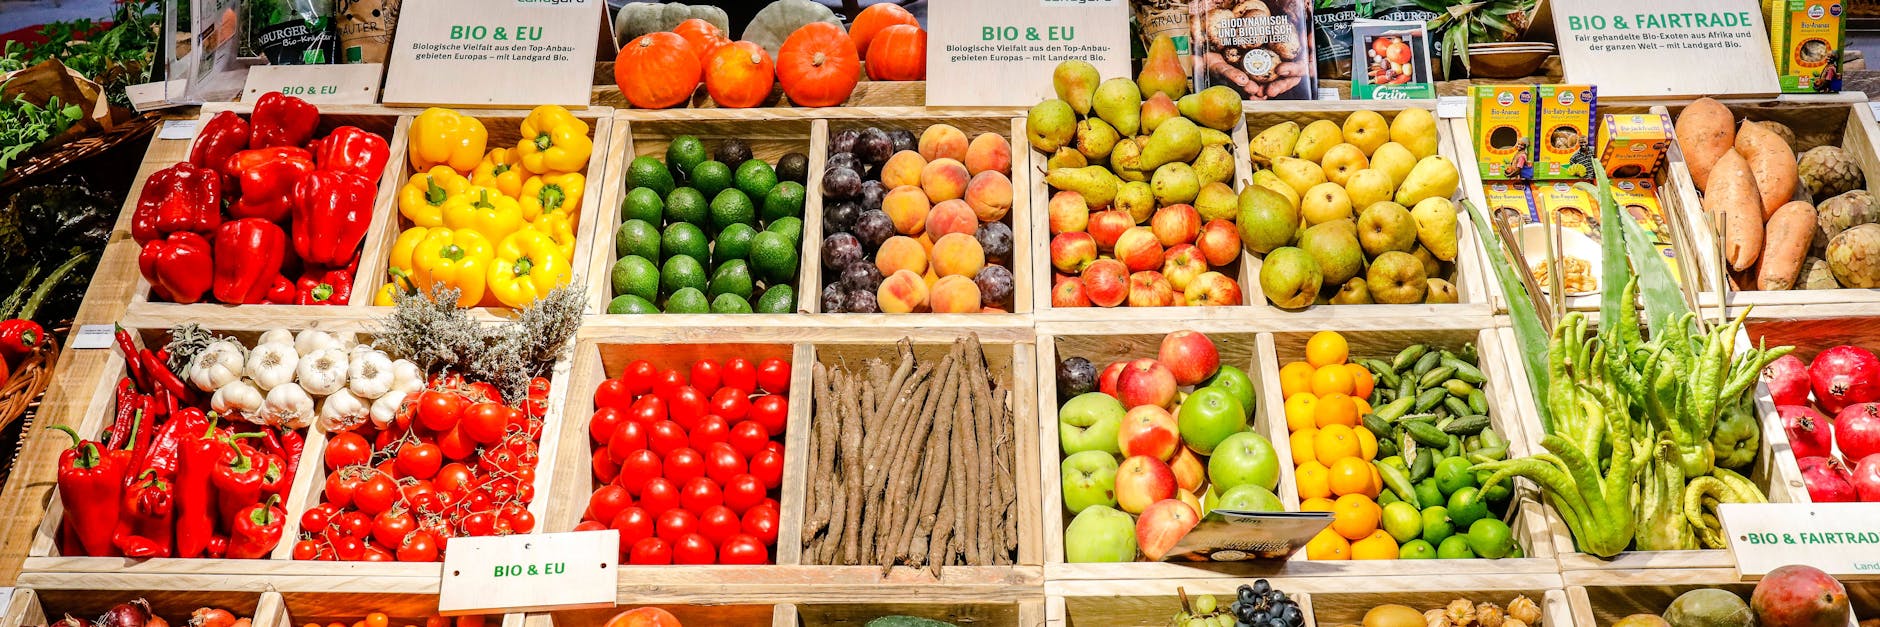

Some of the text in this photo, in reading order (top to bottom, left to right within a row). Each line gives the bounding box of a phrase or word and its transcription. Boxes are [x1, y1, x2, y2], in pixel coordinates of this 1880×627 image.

[1221, 15, 1288, 28] BIODYNAMISCH
[1568, 12, 1753, 30] BIO & FAIRTRADE
[450, 25, 543, 41] BIO & EU
[982, 26, 1074, 41] BIO & EU
[1218, 25, 1292, 38] UND BIOLOGISCH
[1575, 34, 1590, 42] Fair
[1592, 33, 1640, 42] gehandelte
[1642, 32, 1689, 40] Bio-Exoten
[1708, 31, 1733, 39] Afrika
[1221, 38, 1232, 46] UM
[1269, 34, 1291, 43] LEBEN
[412, 43, 461, 51] Biologische
[463, 43, 492, 51] Vielfalt
[529, 44, 575, 53] Top-Anbau-
[946, 45, 995, 53] Biologische
[996, 44, 1026, 52] Vielfalt
[1064, 45, 1111, 53] Top-Anbau-
[1605, 44, 1636, 52] ganzen
[1682, 42, 1722, 50] Landgard
[1725, 41, 1742, 49] Bio.
[415, 52, 452, 60] gebieten
[454, 53, 487, 61] Europas
[496, 53, 510, 61] mit
[512, 54, 550, 62] Landgard
[951, 54, 988, 63] gebieten
[990, 55, 1023, 63] Europas
[282, 85, 337, 95] BIO & EU
[1748, 531, 1880, 544] BIO & FAIRTRAD
[494, 562, 565, 577] BIO & EU
